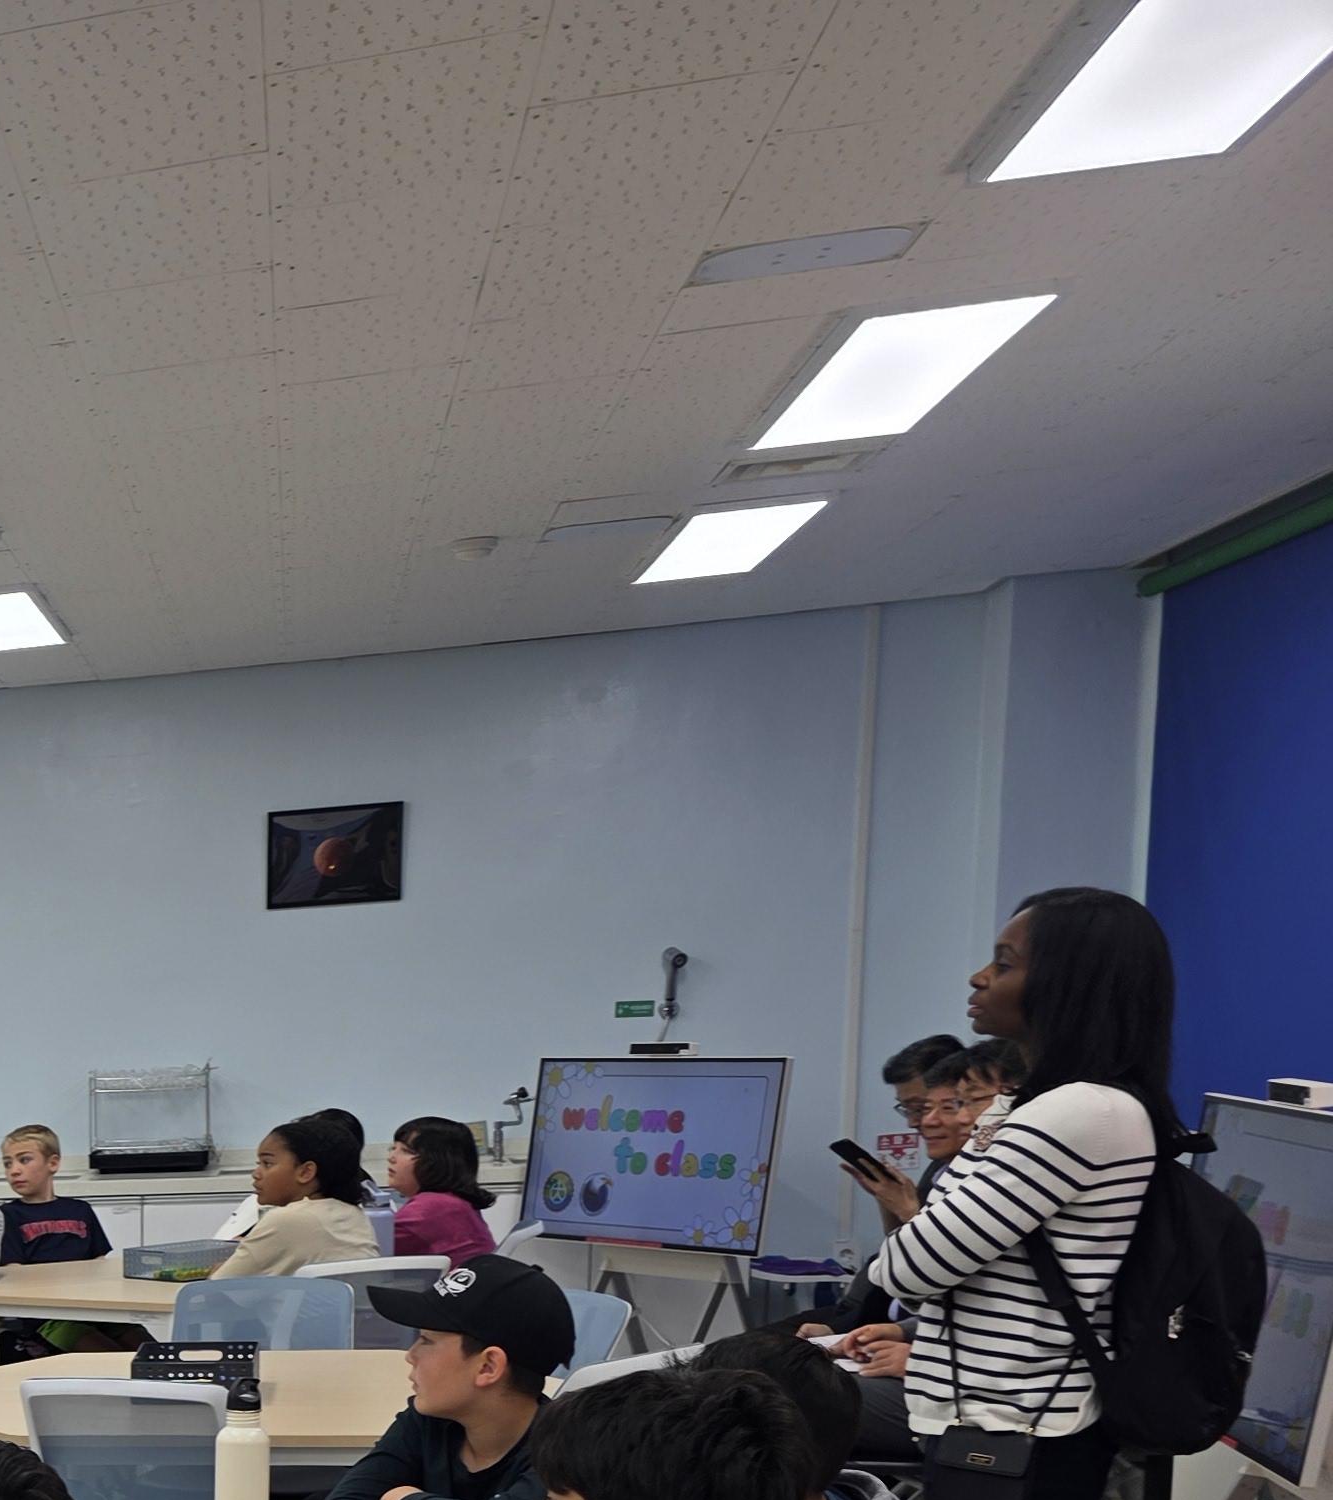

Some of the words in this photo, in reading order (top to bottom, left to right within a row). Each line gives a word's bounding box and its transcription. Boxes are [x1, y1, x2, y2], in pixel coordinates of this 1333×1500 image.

[562, 1094, 685, 1133] welcome
[613, 1136, 648, 1175] to
[654, 1139, 737, 1180] class
